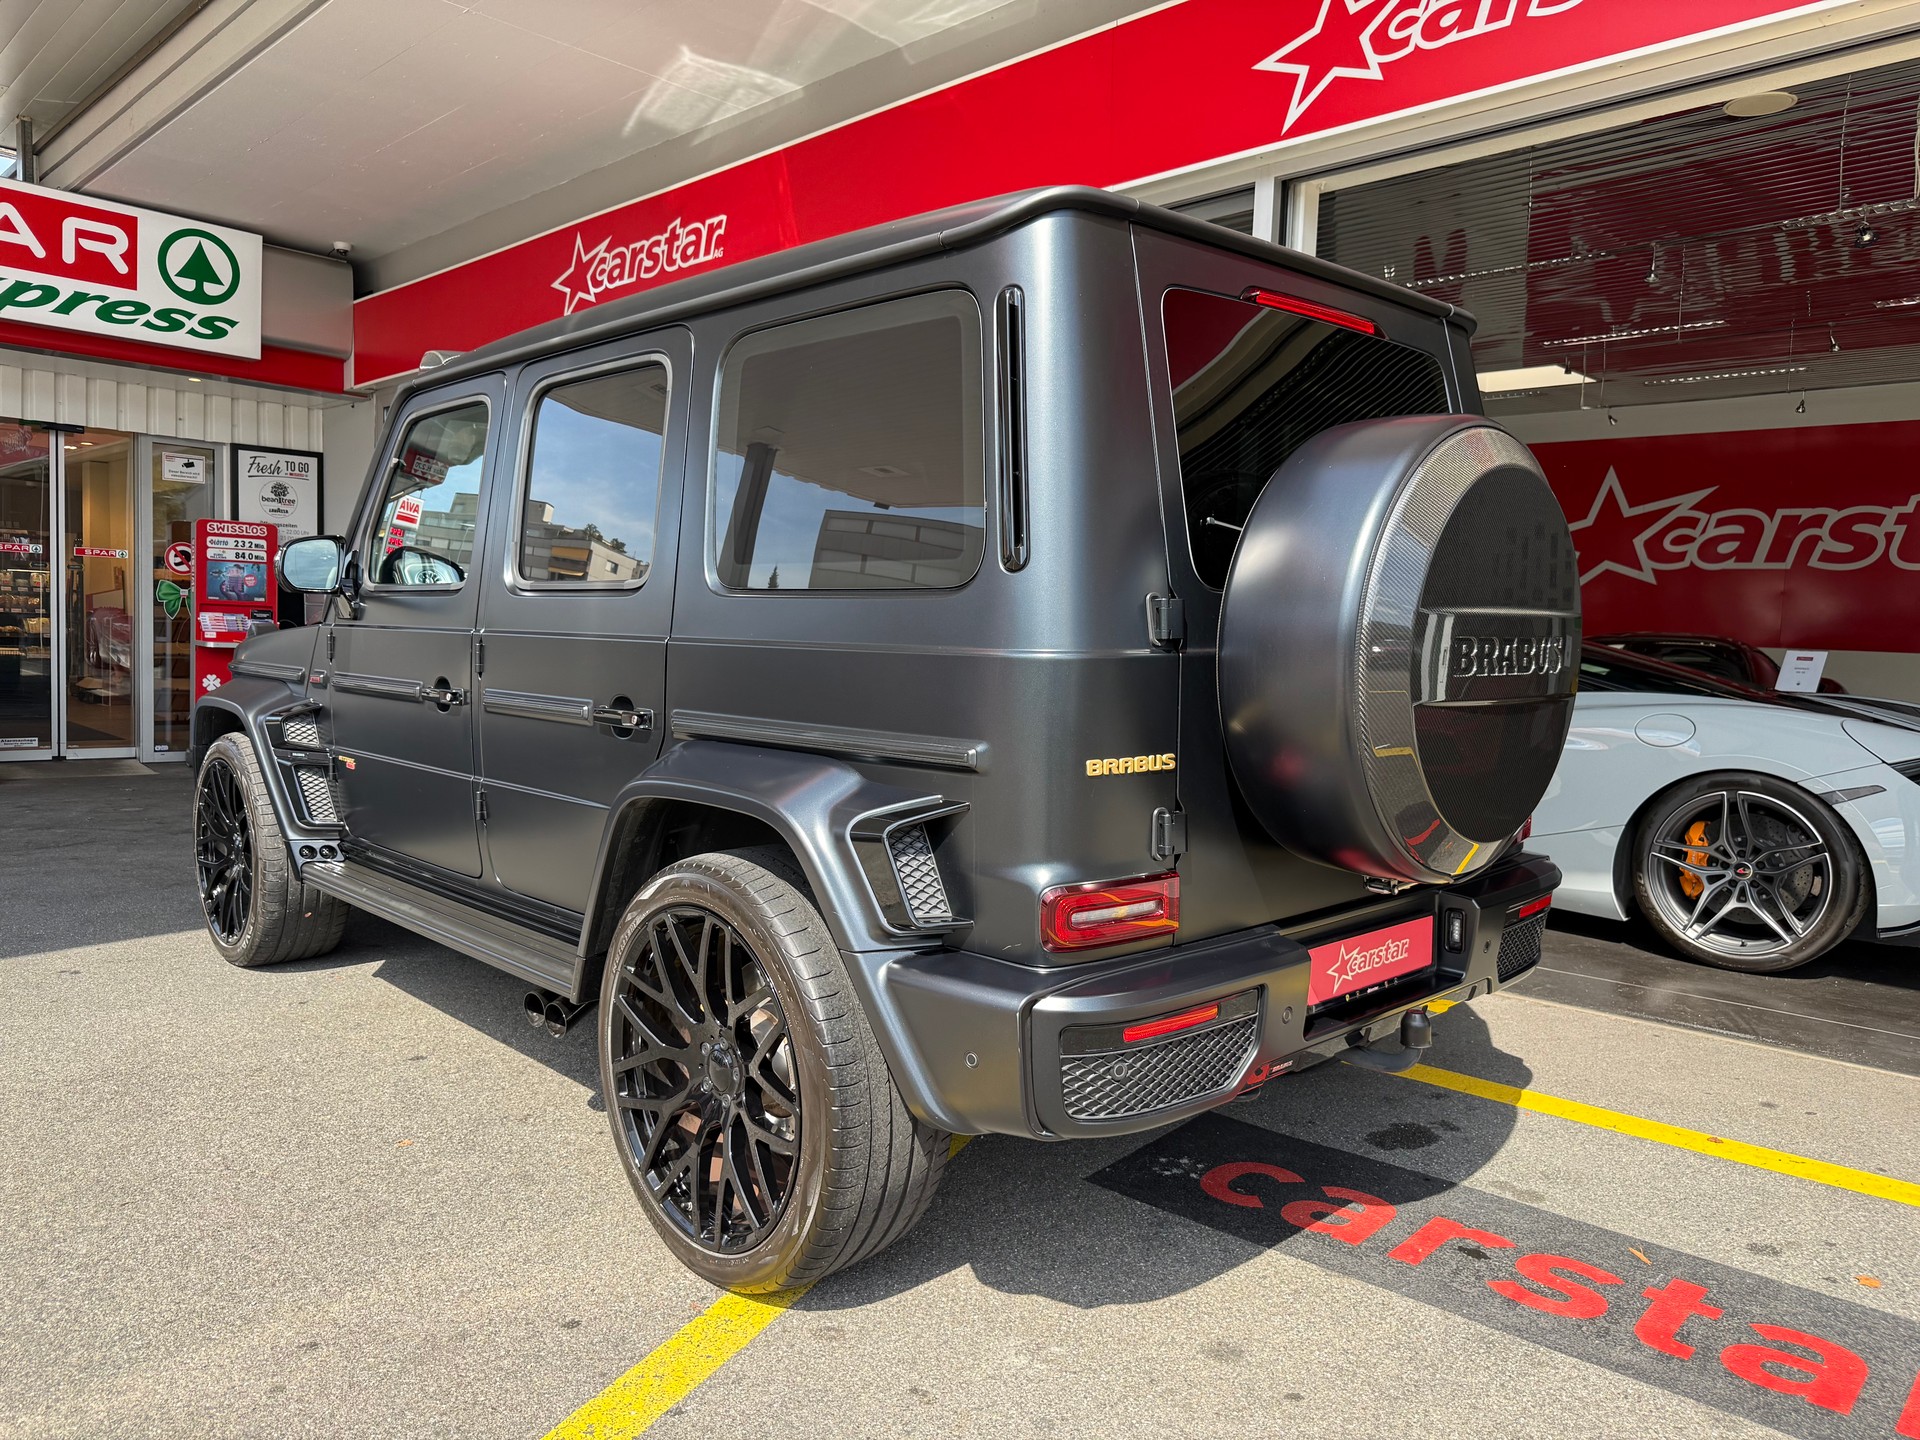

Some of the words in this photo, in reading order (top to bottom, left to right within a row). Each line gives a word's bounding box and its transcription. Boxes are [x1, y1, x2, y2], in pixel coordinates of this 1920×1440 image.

[590, 214, 727, 293] carstar
[713, 247, 724, 259] AG
[0, 277, 240, 340] press
[247, 455, 283, 475] Fresh
[285, 460, 296, 472] TO
[298, 462, 309, 473] GO
[208, 523, 267, 536] SWISSLOS
[1453, 636, 1563, 677] BRABUS
[1086, 753, 1176, 776] BRABUS
[1347, 938, 1410, 975] carstar
[1200, 1162, 1920, 1440] carsta
